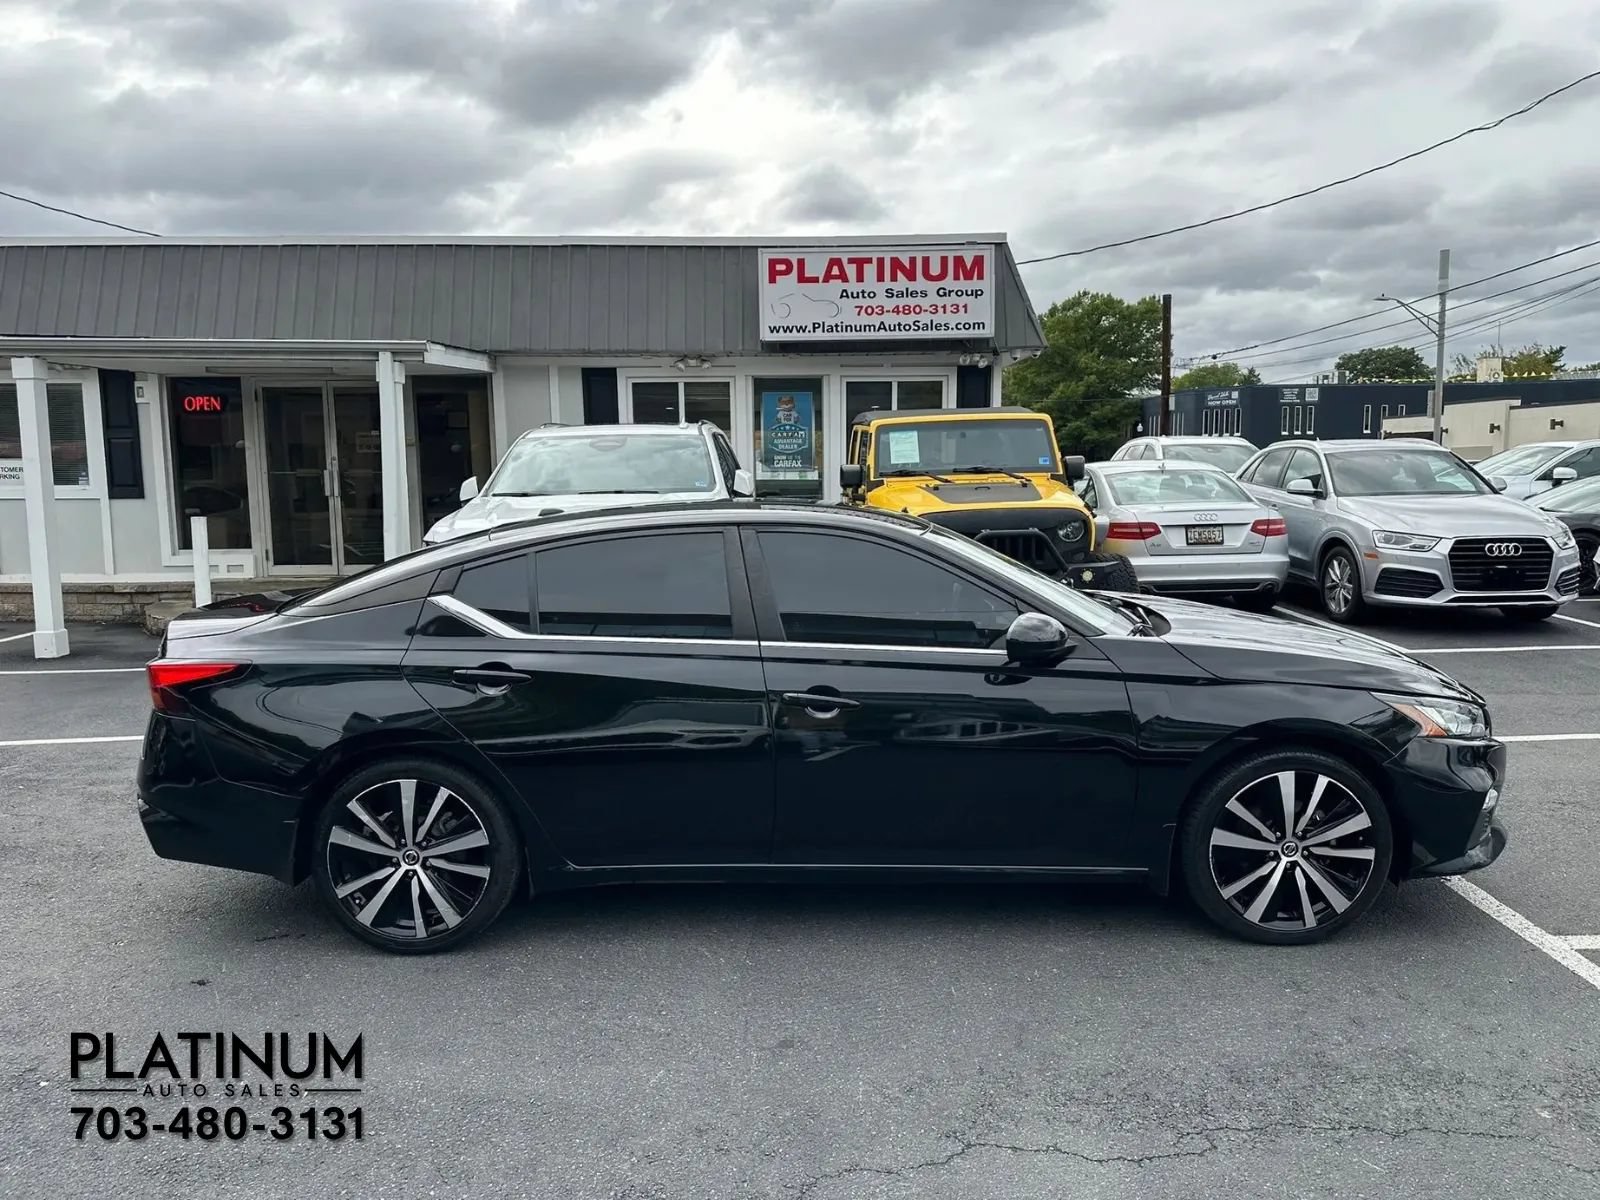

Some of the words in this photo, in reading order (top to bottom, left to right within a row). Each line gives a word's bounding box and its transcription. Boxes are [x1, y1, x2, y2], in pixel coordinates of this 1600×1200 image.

[767, 255, 985, 284] PLATINUM
[839, 288, 877, 300] Auto
[884, 287, 928, 299] Sales
[936, 286, 984, 299] Group
[854, 303, 969, 317] 703-480-3131
[768, 319, 986, 335] www.PlatinumAutoSales.com
[184, 396, 221, 411] OPEN
[774, 459, 802, 468] CARFAX
